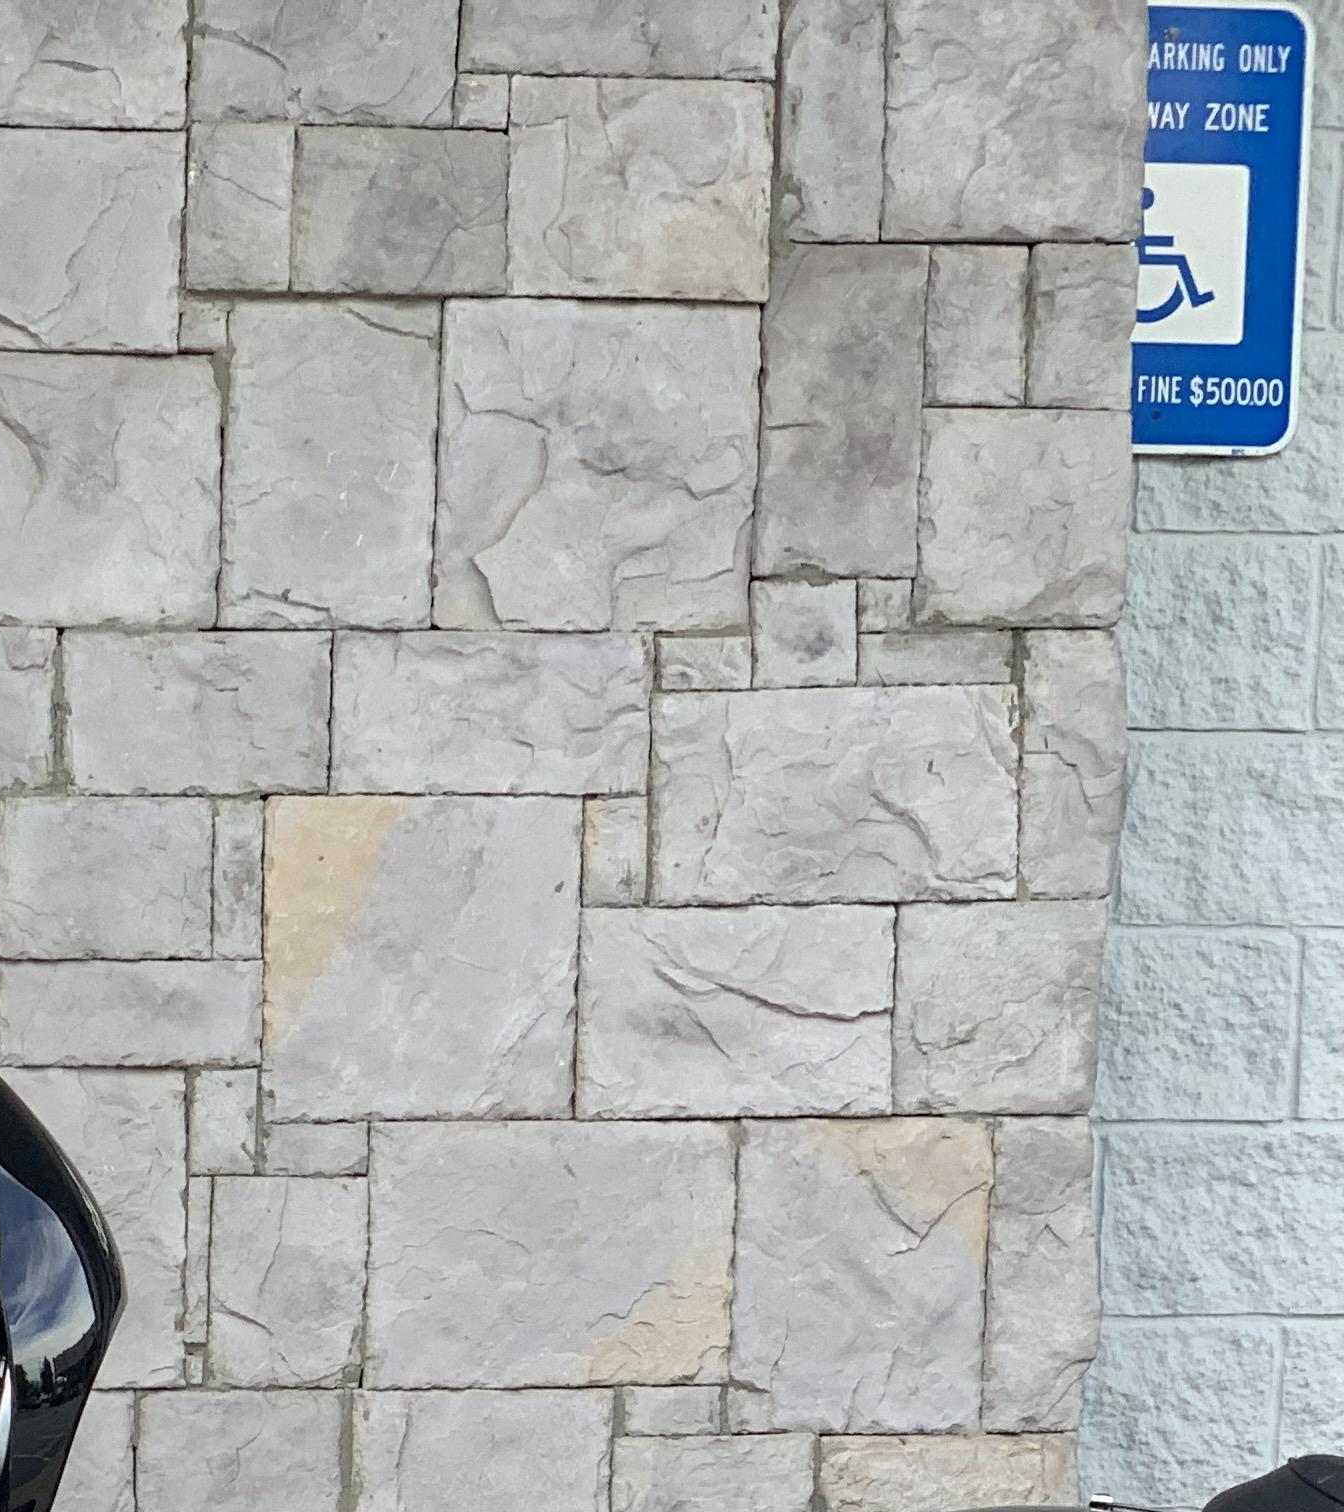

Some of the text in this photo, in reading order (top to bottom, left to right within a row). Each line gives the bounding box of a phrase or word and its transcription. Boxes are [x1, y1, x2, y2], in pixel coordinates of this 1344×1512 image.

[1148, 42, 1291, 73] ARKING ONLY
[1148, 101, 1270, 132] WAY ZONE
[1137, 376, 1182, 404] FINE
